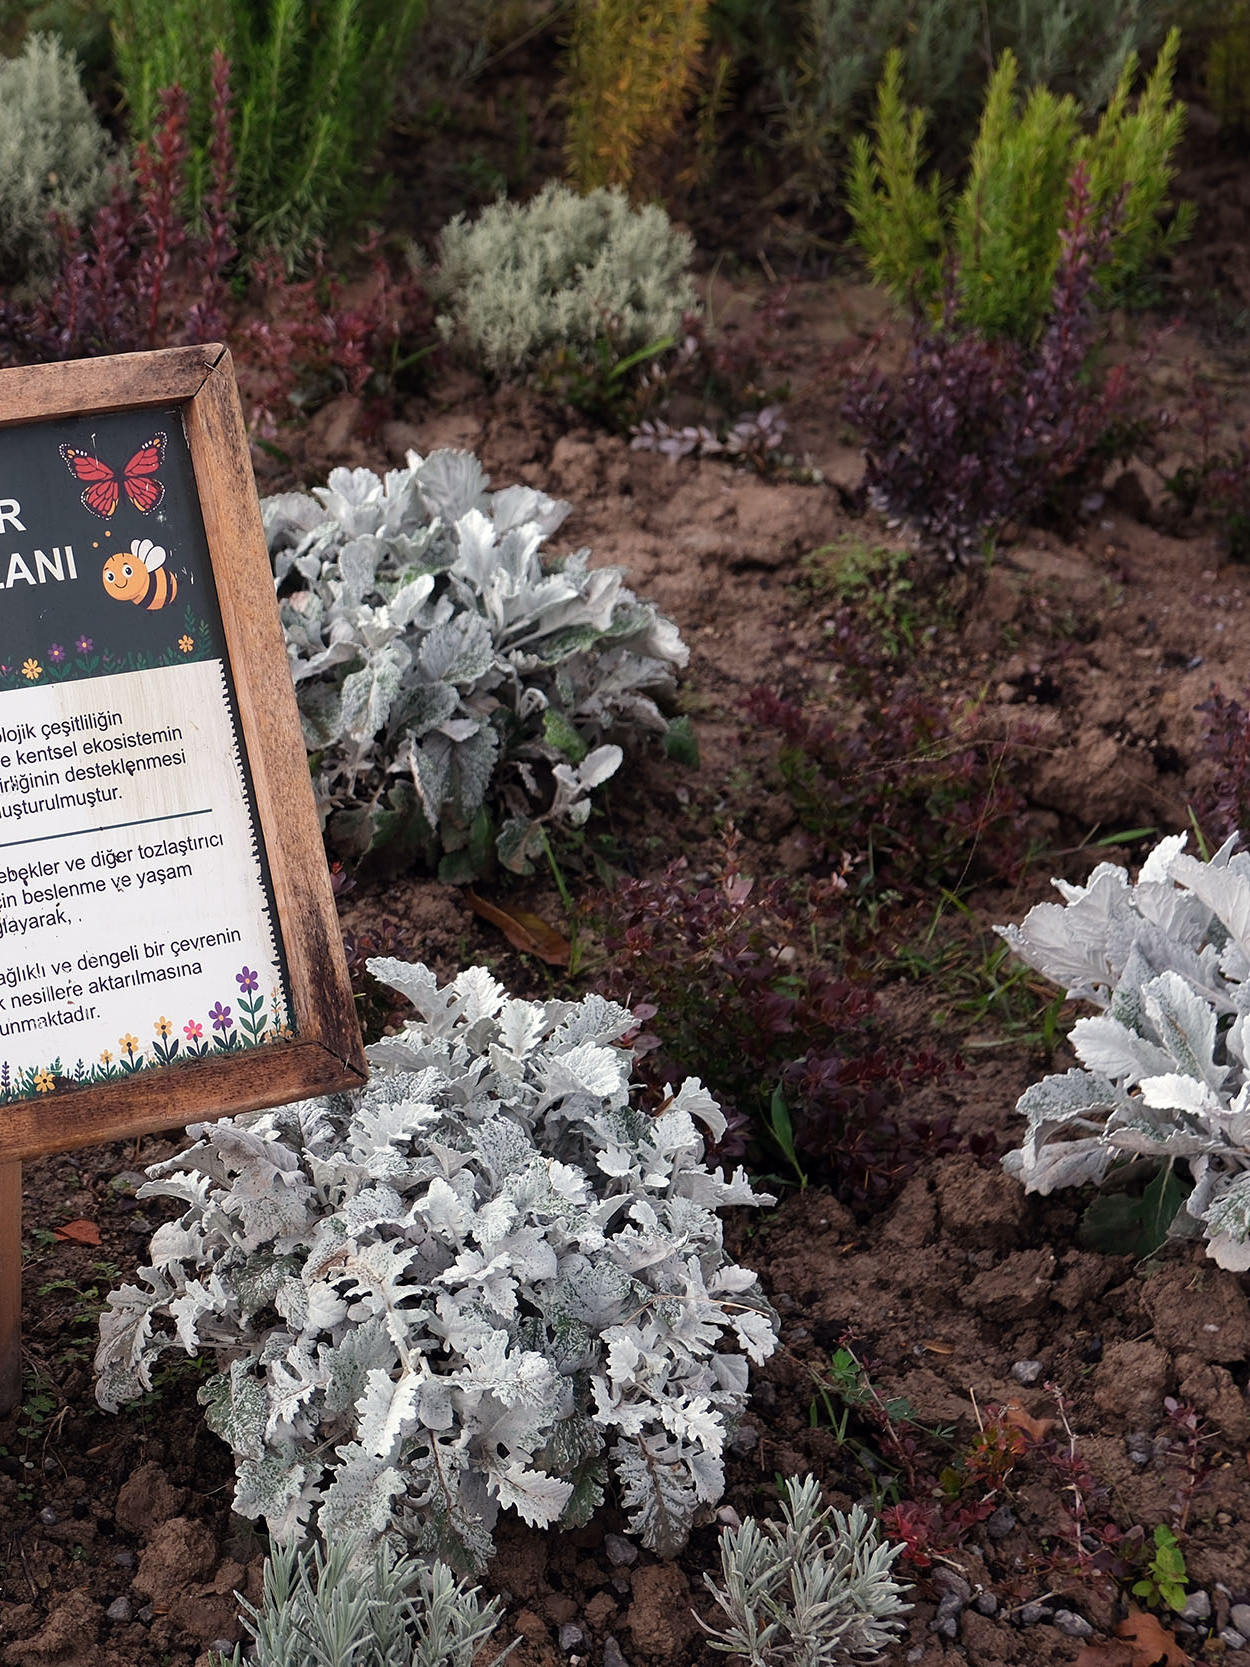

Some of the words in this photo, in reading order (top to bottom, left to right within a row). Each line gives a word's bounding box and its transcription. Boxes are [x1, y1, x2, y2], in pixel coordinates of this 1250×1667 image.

[41, 711, 123, 740] çeşitliliğin
[16, 741, 78, 765] kentsel
[83, 726, 183, 754] ekosistemin
[65, 748, 186, 782] desteklenmesi
[65, 858, 86, 872] ve
[91, 849, 133, 869] diğer
[138, 834, 224, 860] tozlaştırıcı
[22, 879, 106, 906] beslenme
[111, 875, 131, 889] ve
[137, 864, 193, 888] yaşam
[51, 961, 72, 975] ve
[78, 945, 139, 970] dengeli
[144, 942, 165, 958] bir
[171, 928, 241, 957] çevrenin
[11, 984, 83, 1009] nesillere
[89, 961, 202, 994] aktarılmasına
